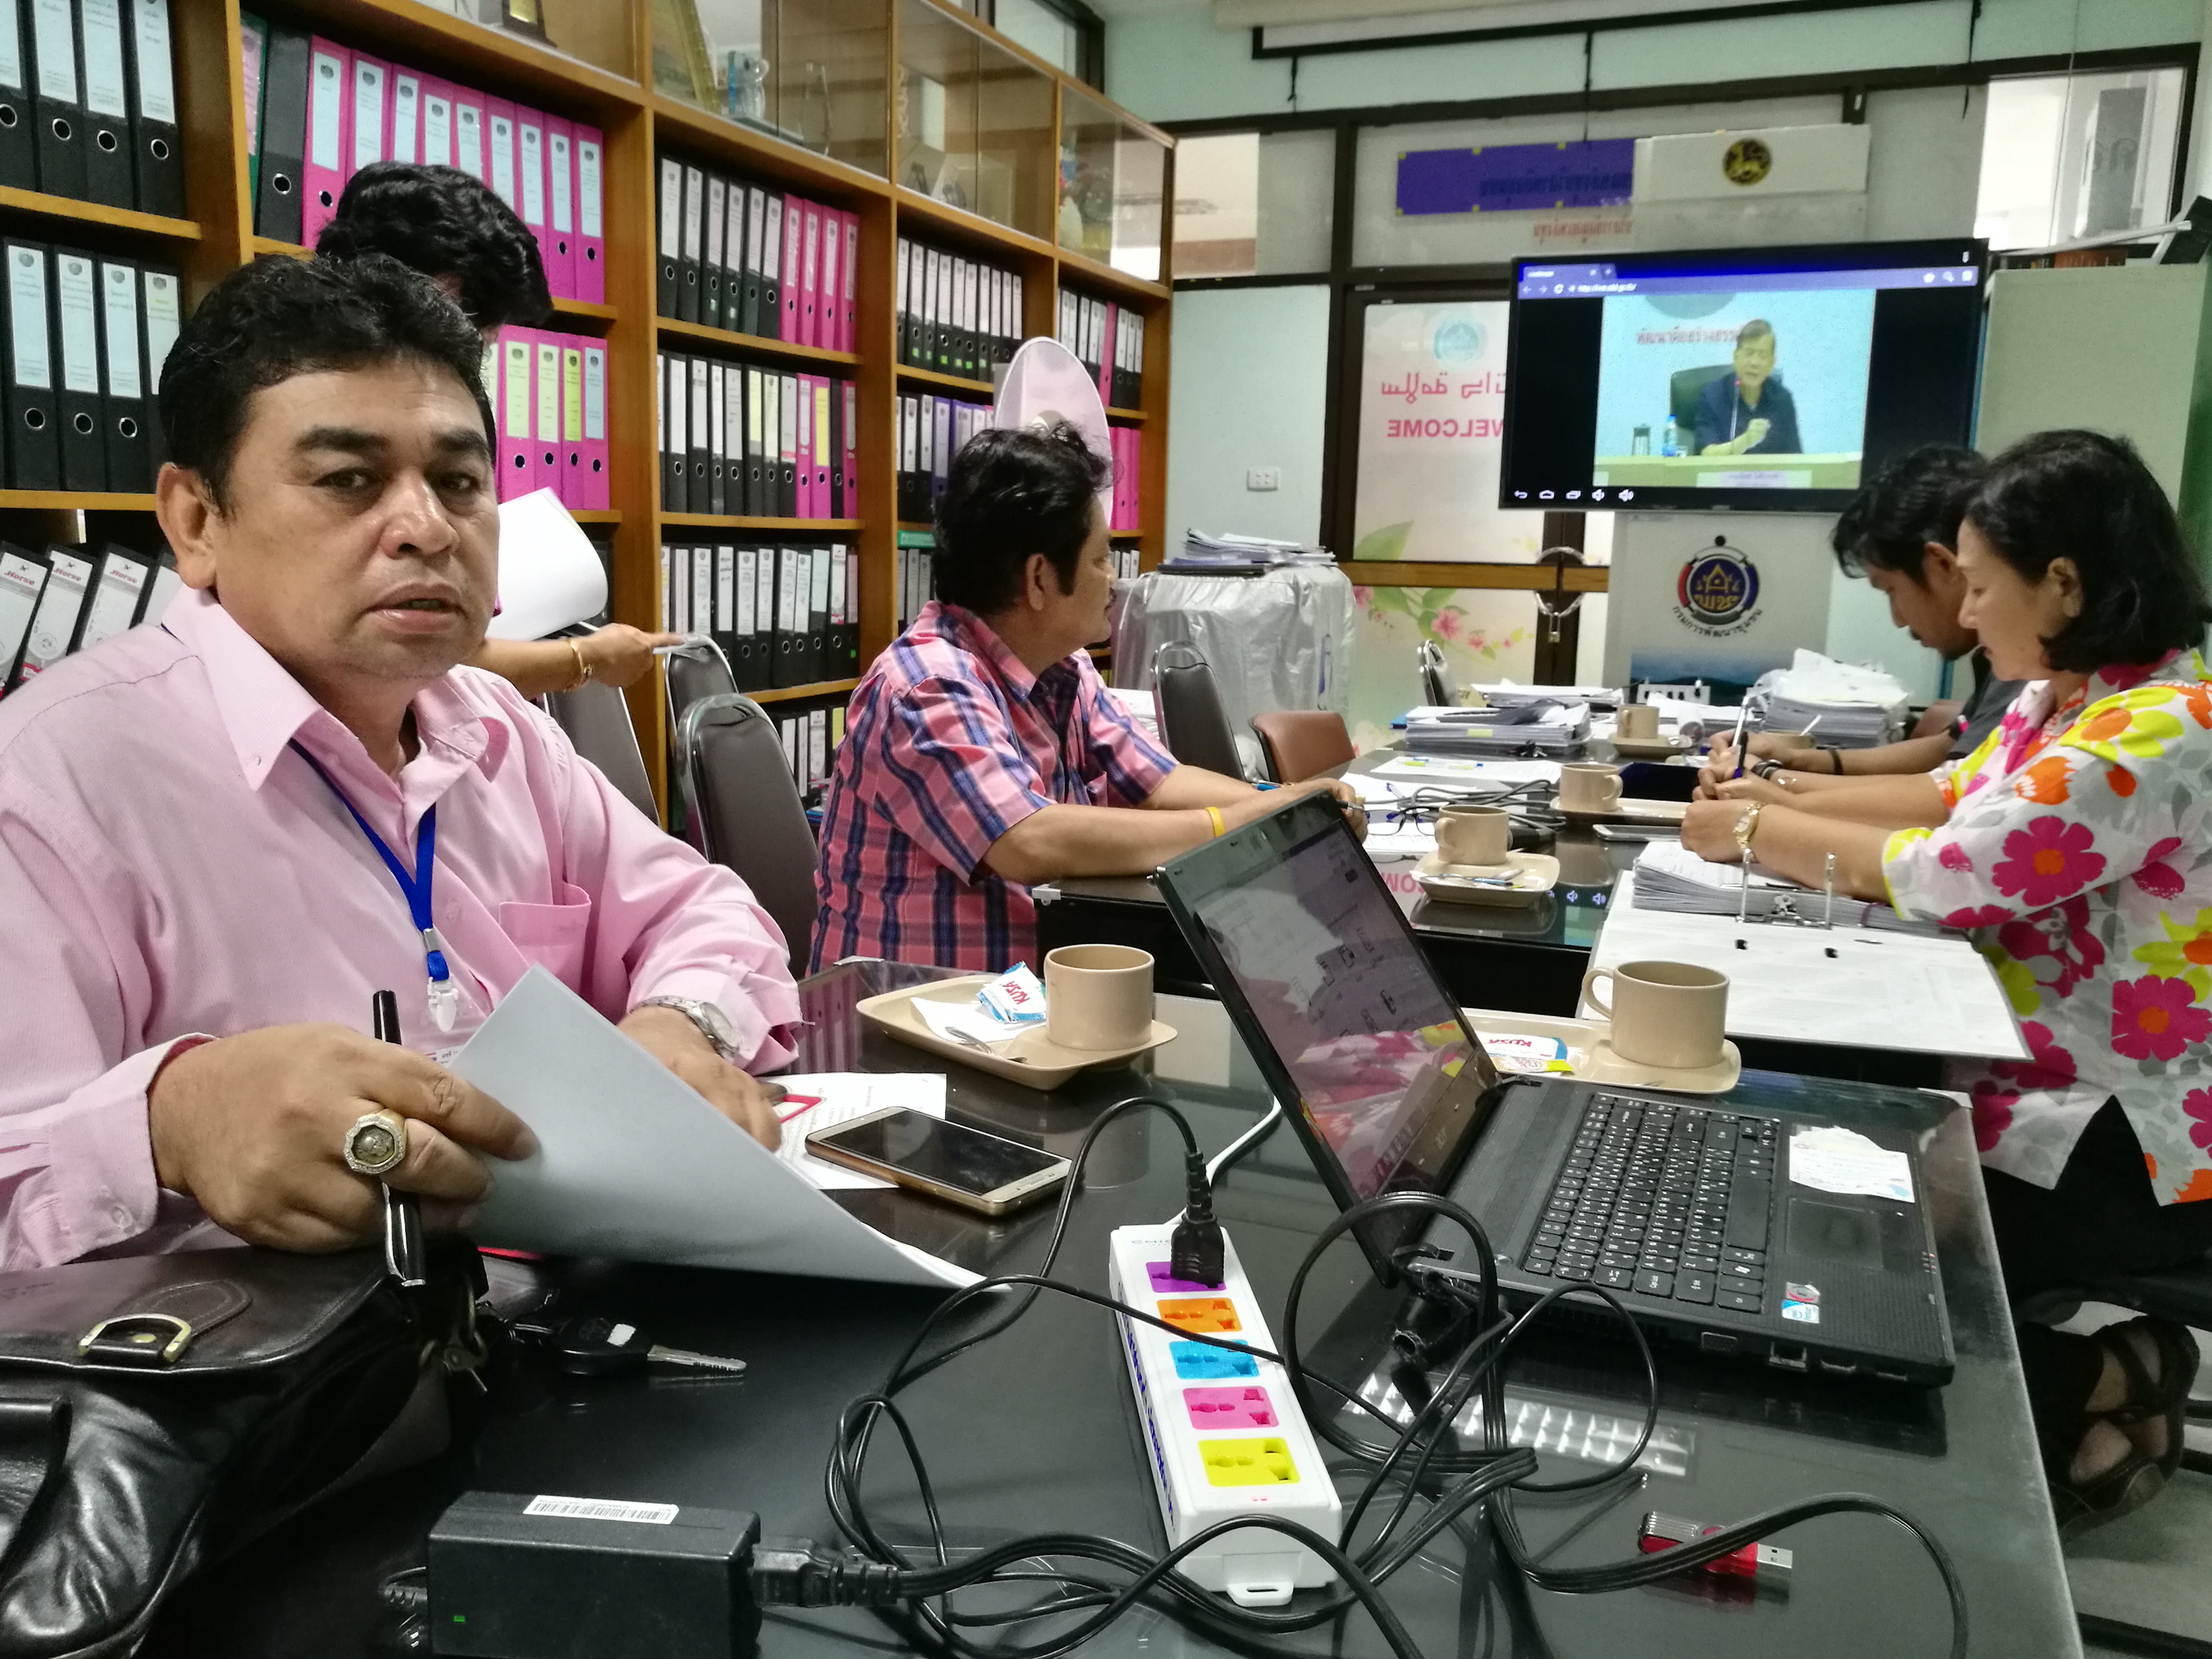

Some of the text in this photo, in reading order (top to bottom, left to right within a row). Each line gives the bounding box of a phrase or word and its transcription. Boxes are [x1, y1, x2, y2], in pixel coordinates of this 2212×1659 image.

[4, 571, 35, 585] Horse
[54, 568, 81, 581] Horse
[110, 570, 138, 584] Horse
